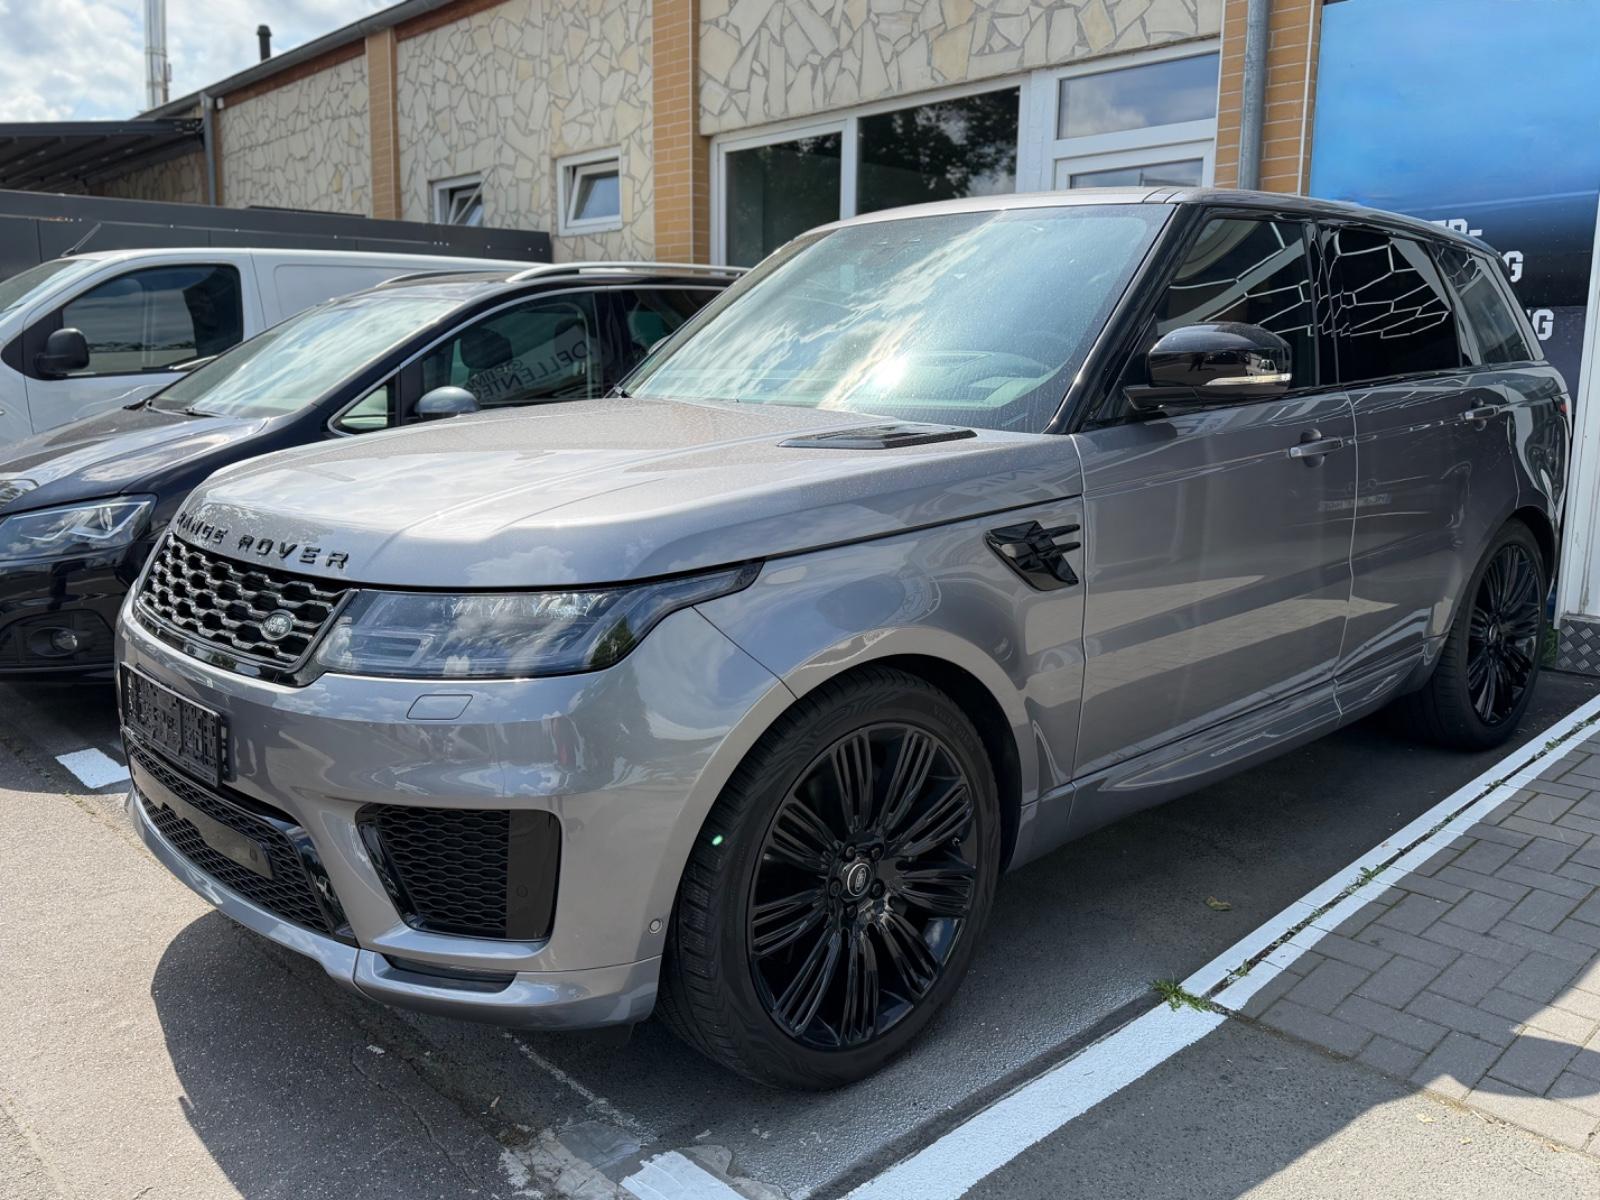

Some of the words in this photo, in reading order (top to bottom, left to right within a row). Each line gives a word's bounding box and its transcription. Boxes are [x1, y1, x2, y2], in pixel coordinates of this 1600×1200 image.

[1498, 250, 1524, 283] G
[1526, 308, 1555, 341] G
[177, 511, 228, 544] RANGE
[238, 535, 349, 569] ROVER
